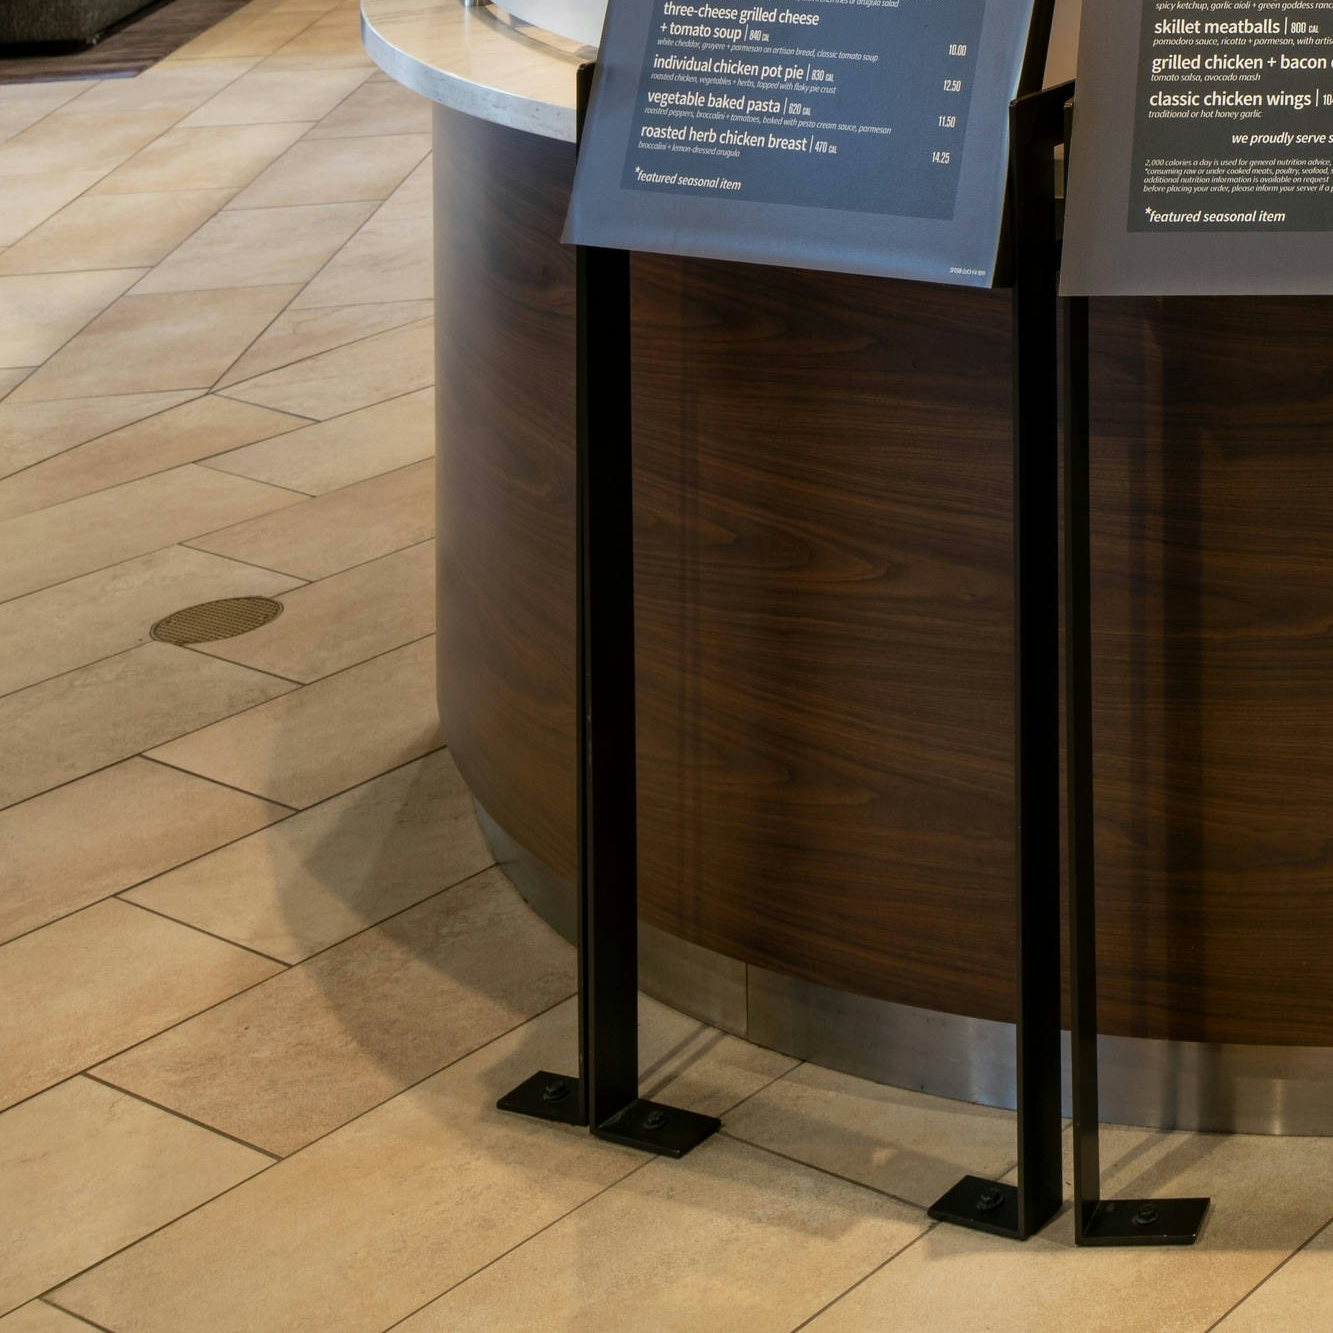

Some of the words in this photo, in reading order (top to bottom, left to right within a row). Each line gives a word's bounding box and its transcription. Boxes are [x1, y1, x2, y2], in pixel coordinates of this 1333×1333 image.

[664, 1, 738, 20] three-cheese
[739, 6, 778, 24] grilled
[778, 9, 820, 26] cheese
[669, 22, 712, 37] tomato
[713, 27, 742, 43] soup
[1154, 19, 1201, 34] skillet
[1204, 18, 1280, 34] meatballs
[653, 54, 713, 72] individual
[713, 59, 759, 76] chicken
[760, 65, 783, 80] pot
[784, 64, 804, 82] pie
[1151, 54, 1201, 73] grilled
[1204, 54, 1263, 69] chicken
[1280, 54, 1327, 69] bacon
[1150, 73, 1180, 82] tomato
[1204, 73, 1237, 82] avocado
[1238, 73, 1261, 82] mash
[648, 91, 705, 108] vegetable
[707, 92, 745, 110] baked
[746, 99, 781, 114] pasta
[1149, 91, 1200, 106] classic
[1203, 90, 1262, 106] chicken
[1266, 90, 1312, 110] wings
[641, 126, 687, 140] roasted
[688, 126, 717, 143] herb
[719, 129, 765, 147] chicken
[767, 133, 808, 151] breast
[1232, 134, 1249, 144] we
[1249, 132, 1295, 146] proudly
[1295, 134, 1326, 144] serve
[932, 151, 950, 164] 14.25
[1203, 210, 1257, 222] seasonal
[1258, 210, 1286, 222] item
